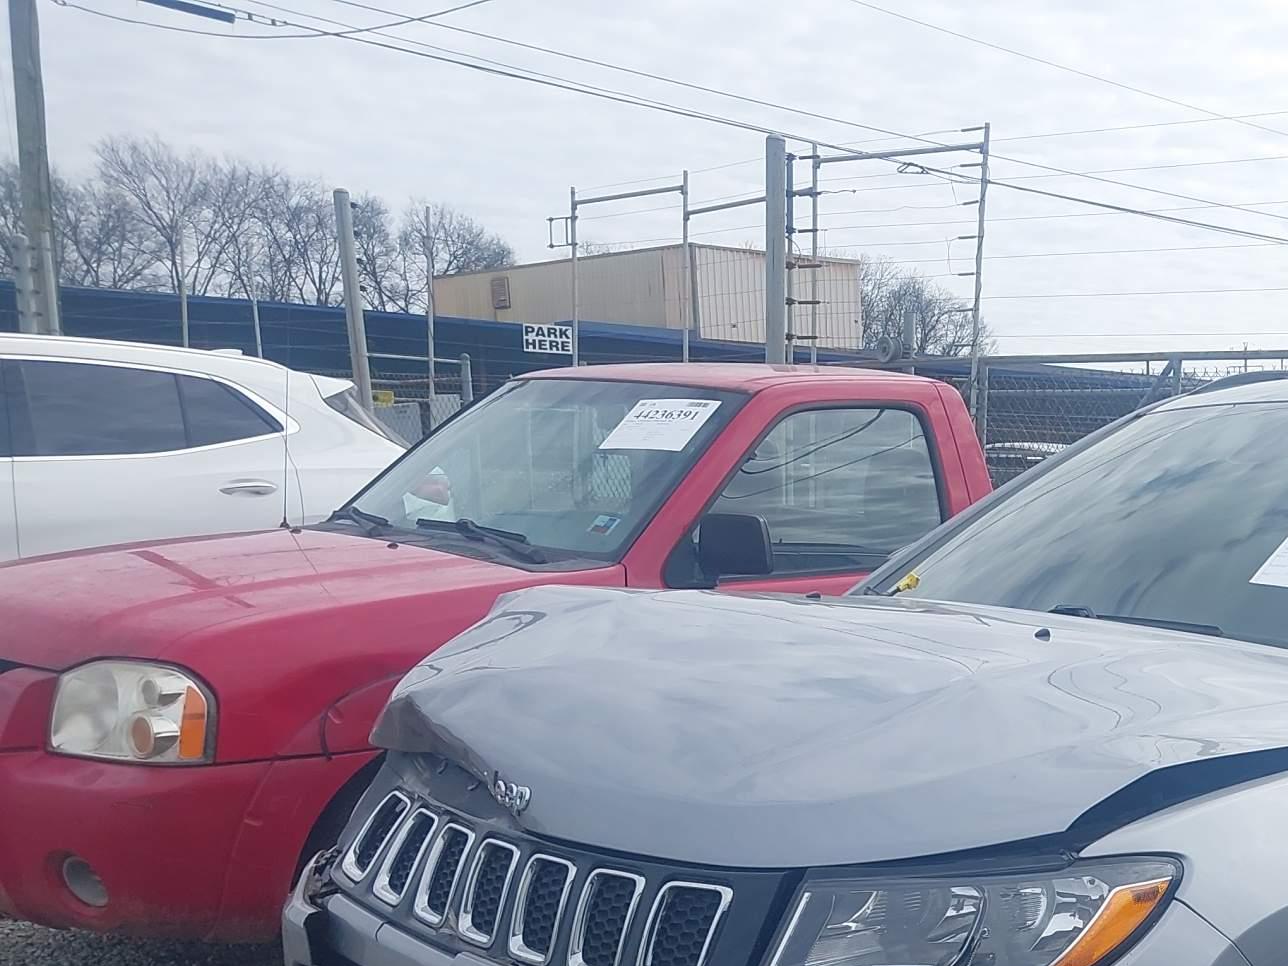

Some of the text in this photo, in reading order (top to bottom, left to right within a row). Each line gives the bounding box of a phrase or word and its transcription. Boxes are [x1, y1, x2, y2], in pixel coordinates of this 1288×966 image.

[524, 325, 571, 340] PARK
[525, 338, 571, 352] HERE
[633, 408, 700, 421] 44236391
